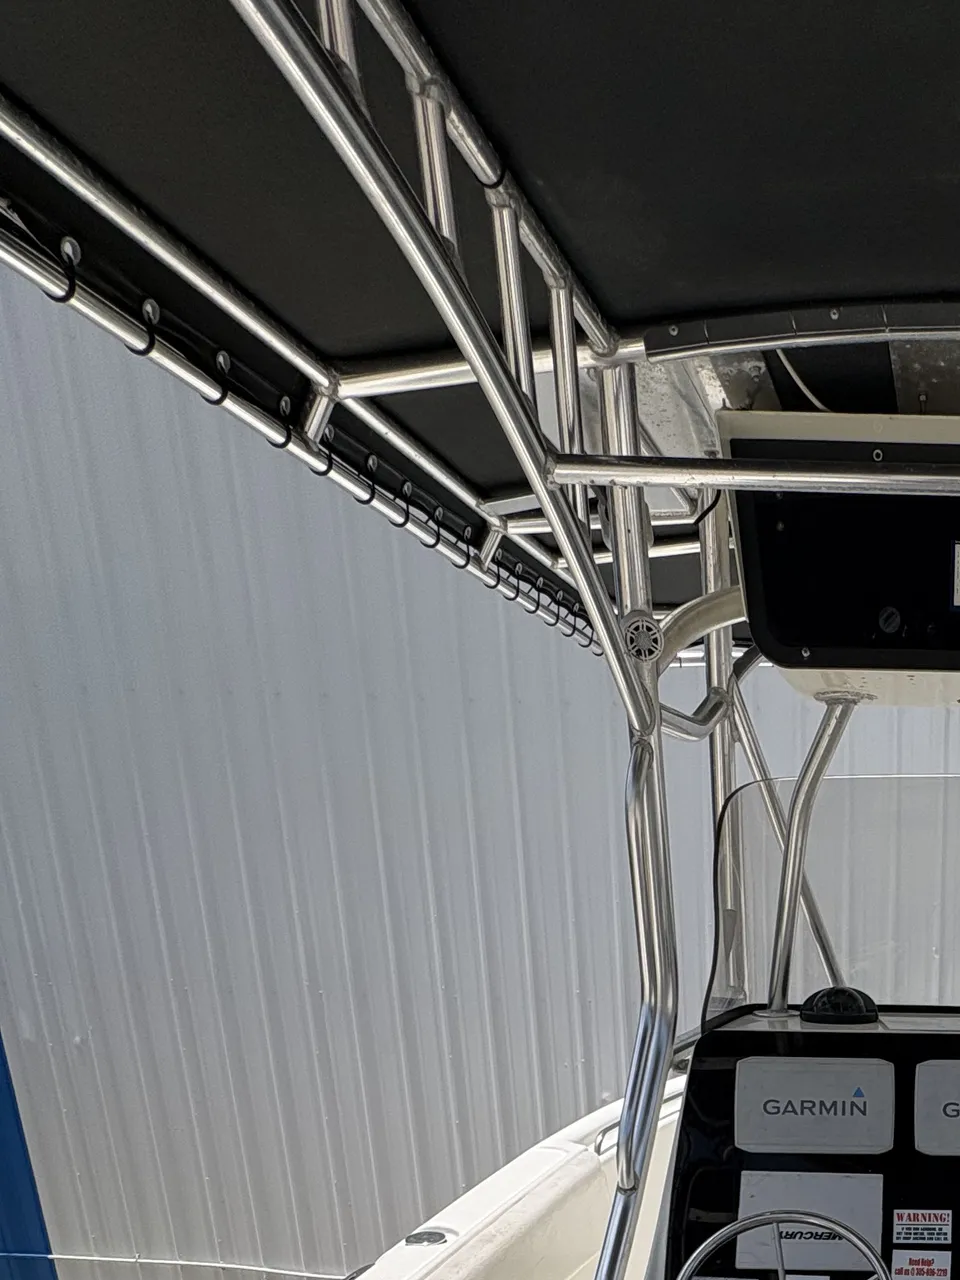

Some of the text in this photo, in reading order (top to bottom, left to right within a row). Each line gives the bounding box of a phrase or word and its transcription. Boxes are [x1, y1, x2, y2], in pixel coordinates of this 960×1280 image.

[762, 1099, 868, 1117] GARMIN
[896, 1212, 950, 1223] WARNING!
[908, 1257, 920, 1266] Need
[895, 1267, 904, 1275] call
